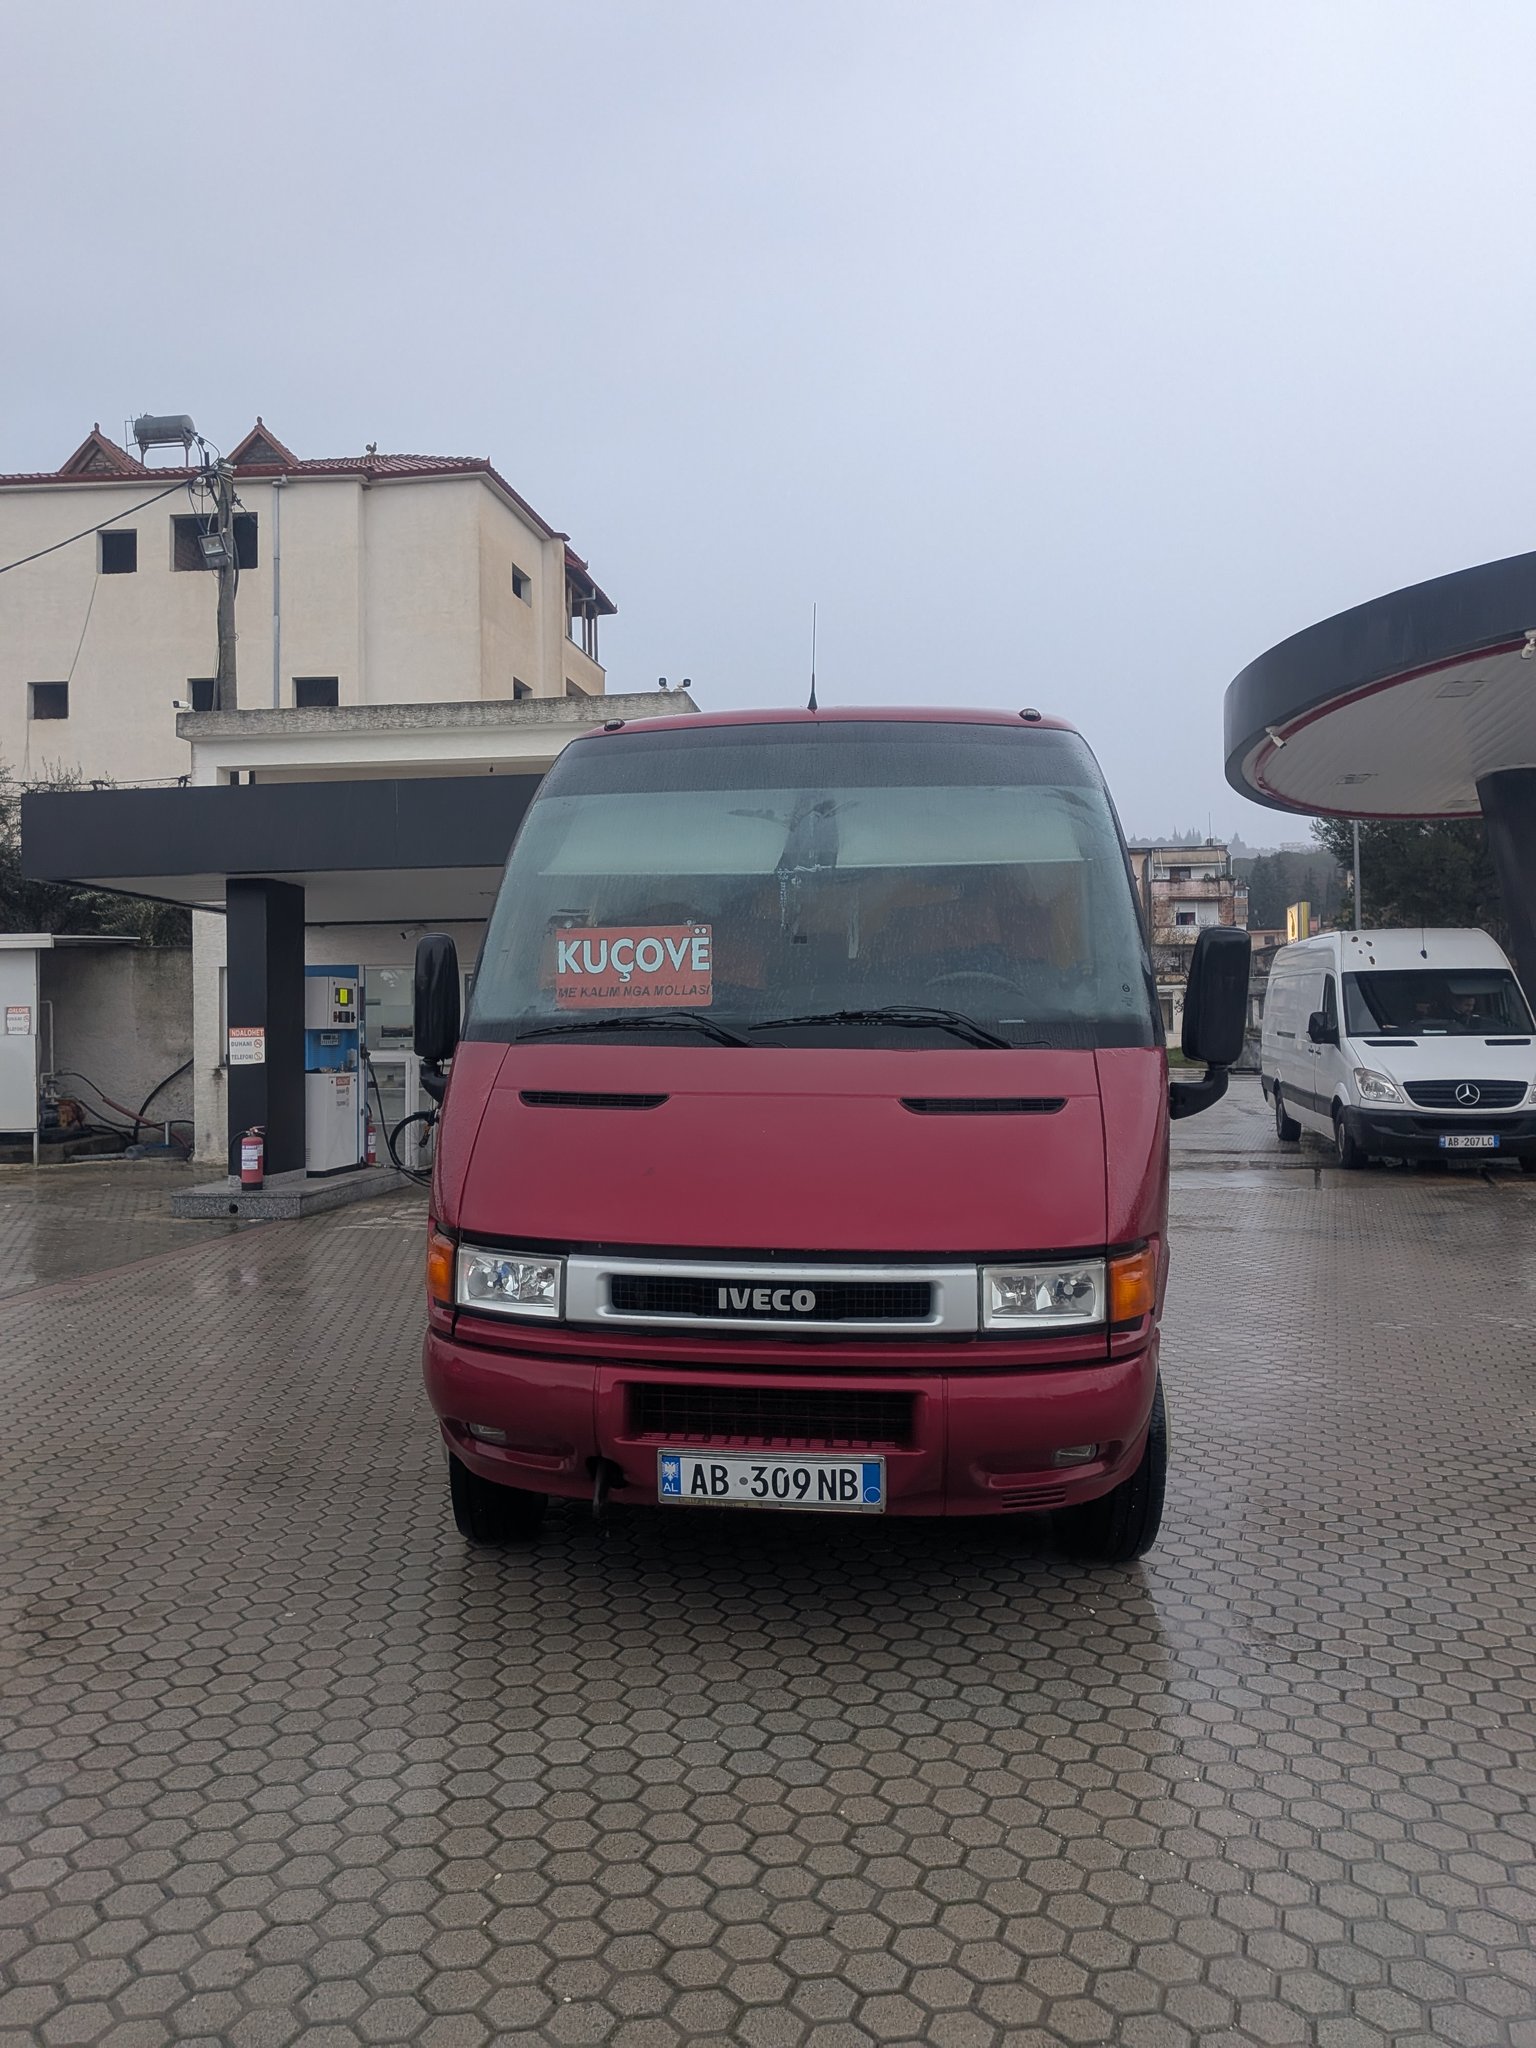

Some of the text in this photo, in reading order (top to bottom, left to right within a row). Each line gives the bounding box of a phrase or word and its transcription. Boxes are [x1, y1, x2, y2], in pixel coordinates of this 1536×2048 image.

[558, 927, 710, 982] KUÇOVË
[558, 984, 711, 998] ME KALIM NGA MOLLASI
[1448, 1137, 1459, 1146] AB
[718, 1287, 816, 1312] IVECO
[663, 1482, 679, 1493] AL
[690, 1463, 729, 1495] AB
